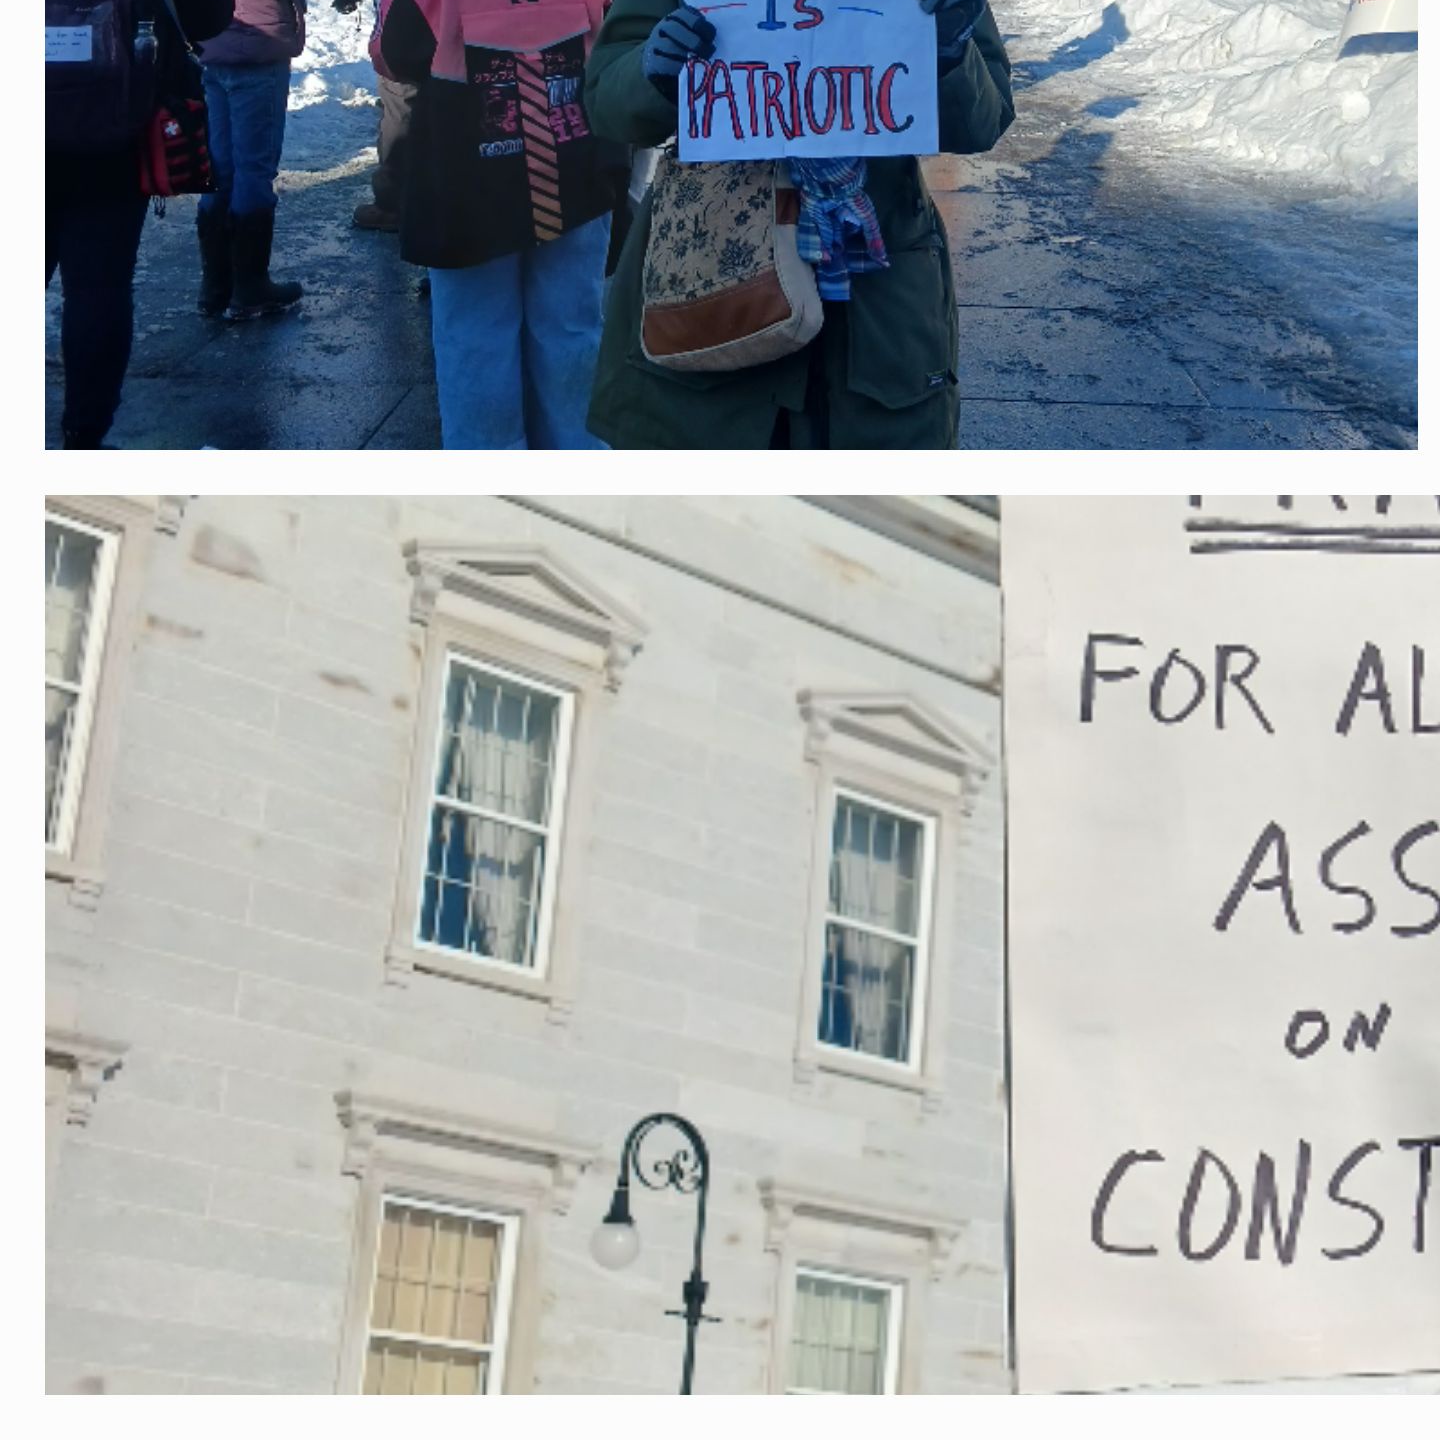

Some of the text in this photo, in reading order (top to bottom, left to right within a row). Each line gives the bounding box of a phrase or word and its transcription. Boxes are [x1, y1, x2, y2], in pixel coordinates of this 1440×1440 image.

[686, 58, 915, 141] PATRIOTIC
[1078, 632, 1276, 735] FOR
[1283, 1001, 1392, 1059] ON
